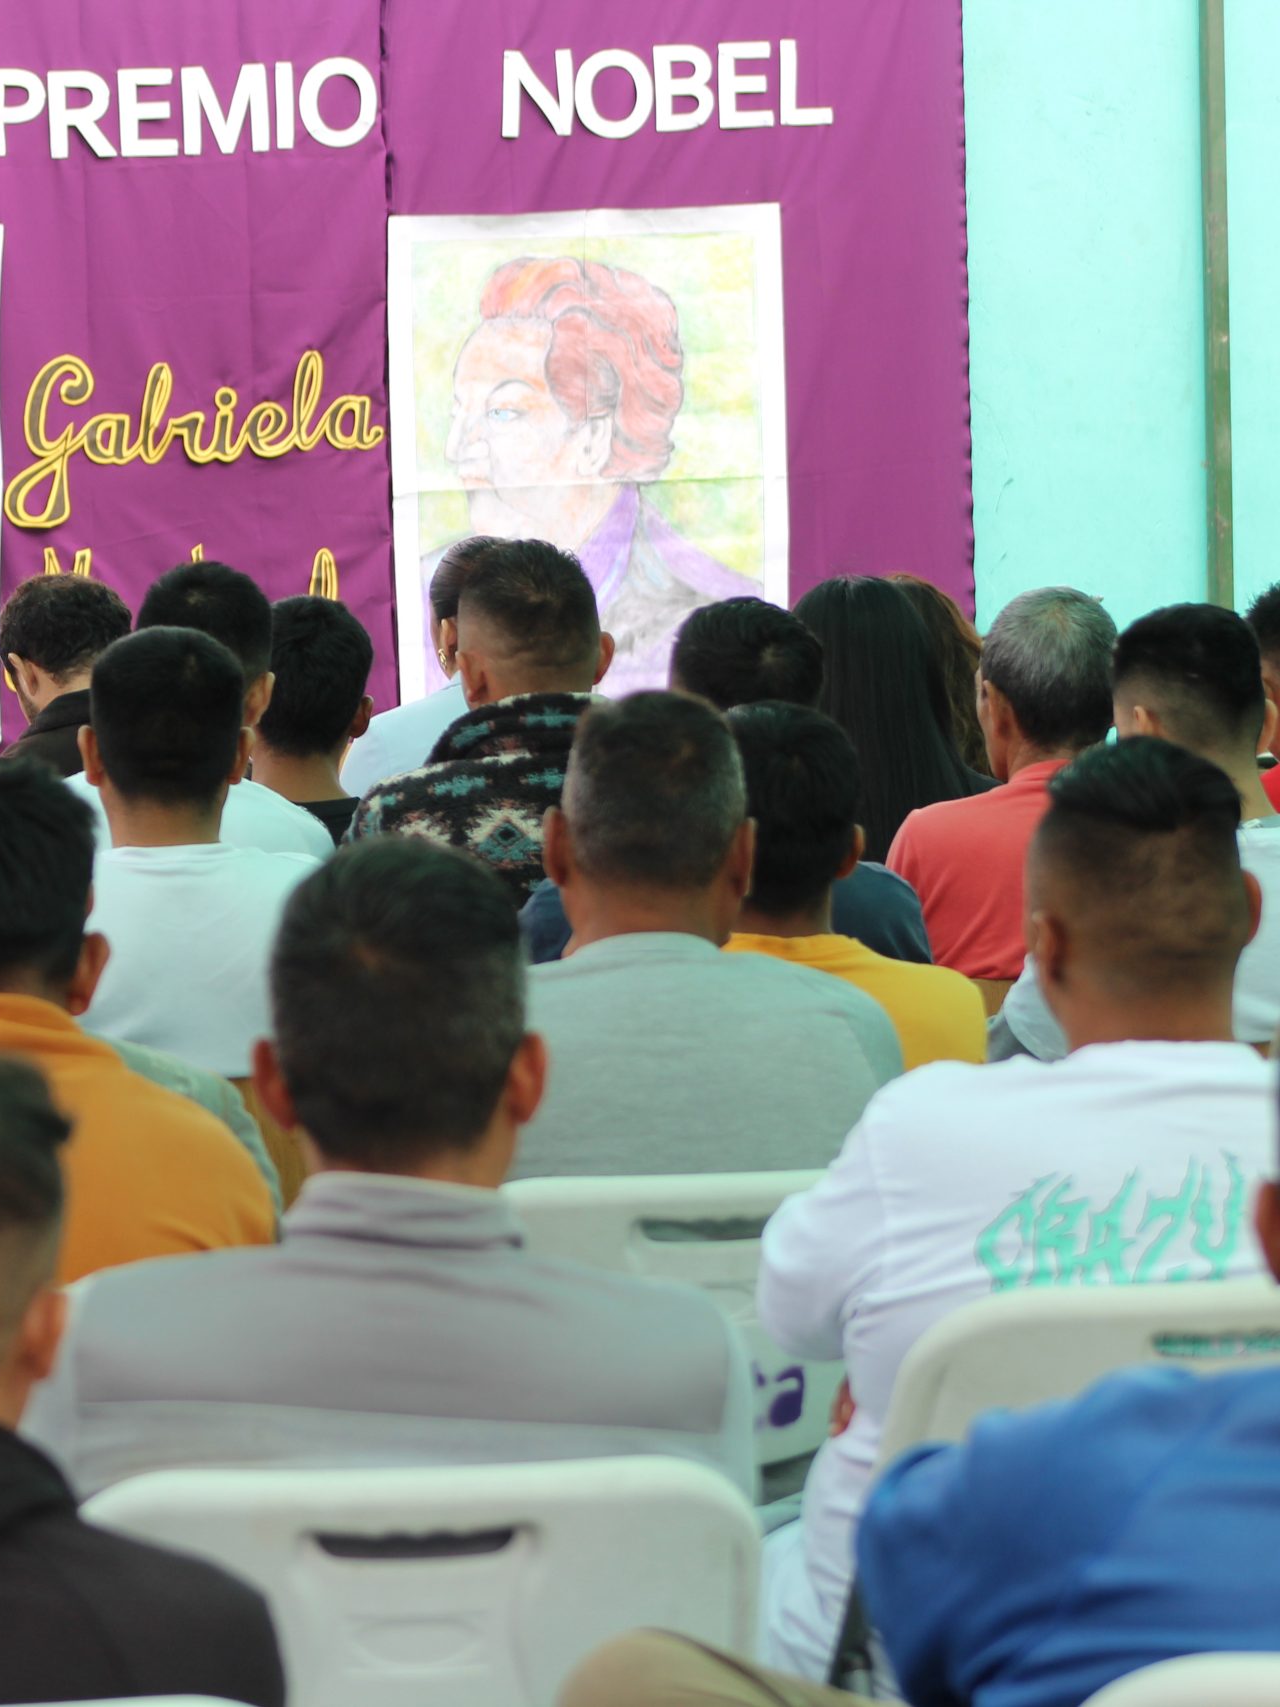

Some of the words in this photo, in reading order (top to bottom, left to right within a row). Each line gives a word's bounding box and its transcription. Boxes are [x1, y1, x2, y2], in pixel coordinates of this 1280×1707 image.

[502, 39, 834, 140] NOBEL
[4, 350, 384, 529] Gabriela
[973, 1147, 1246, 1293] CRAZY
